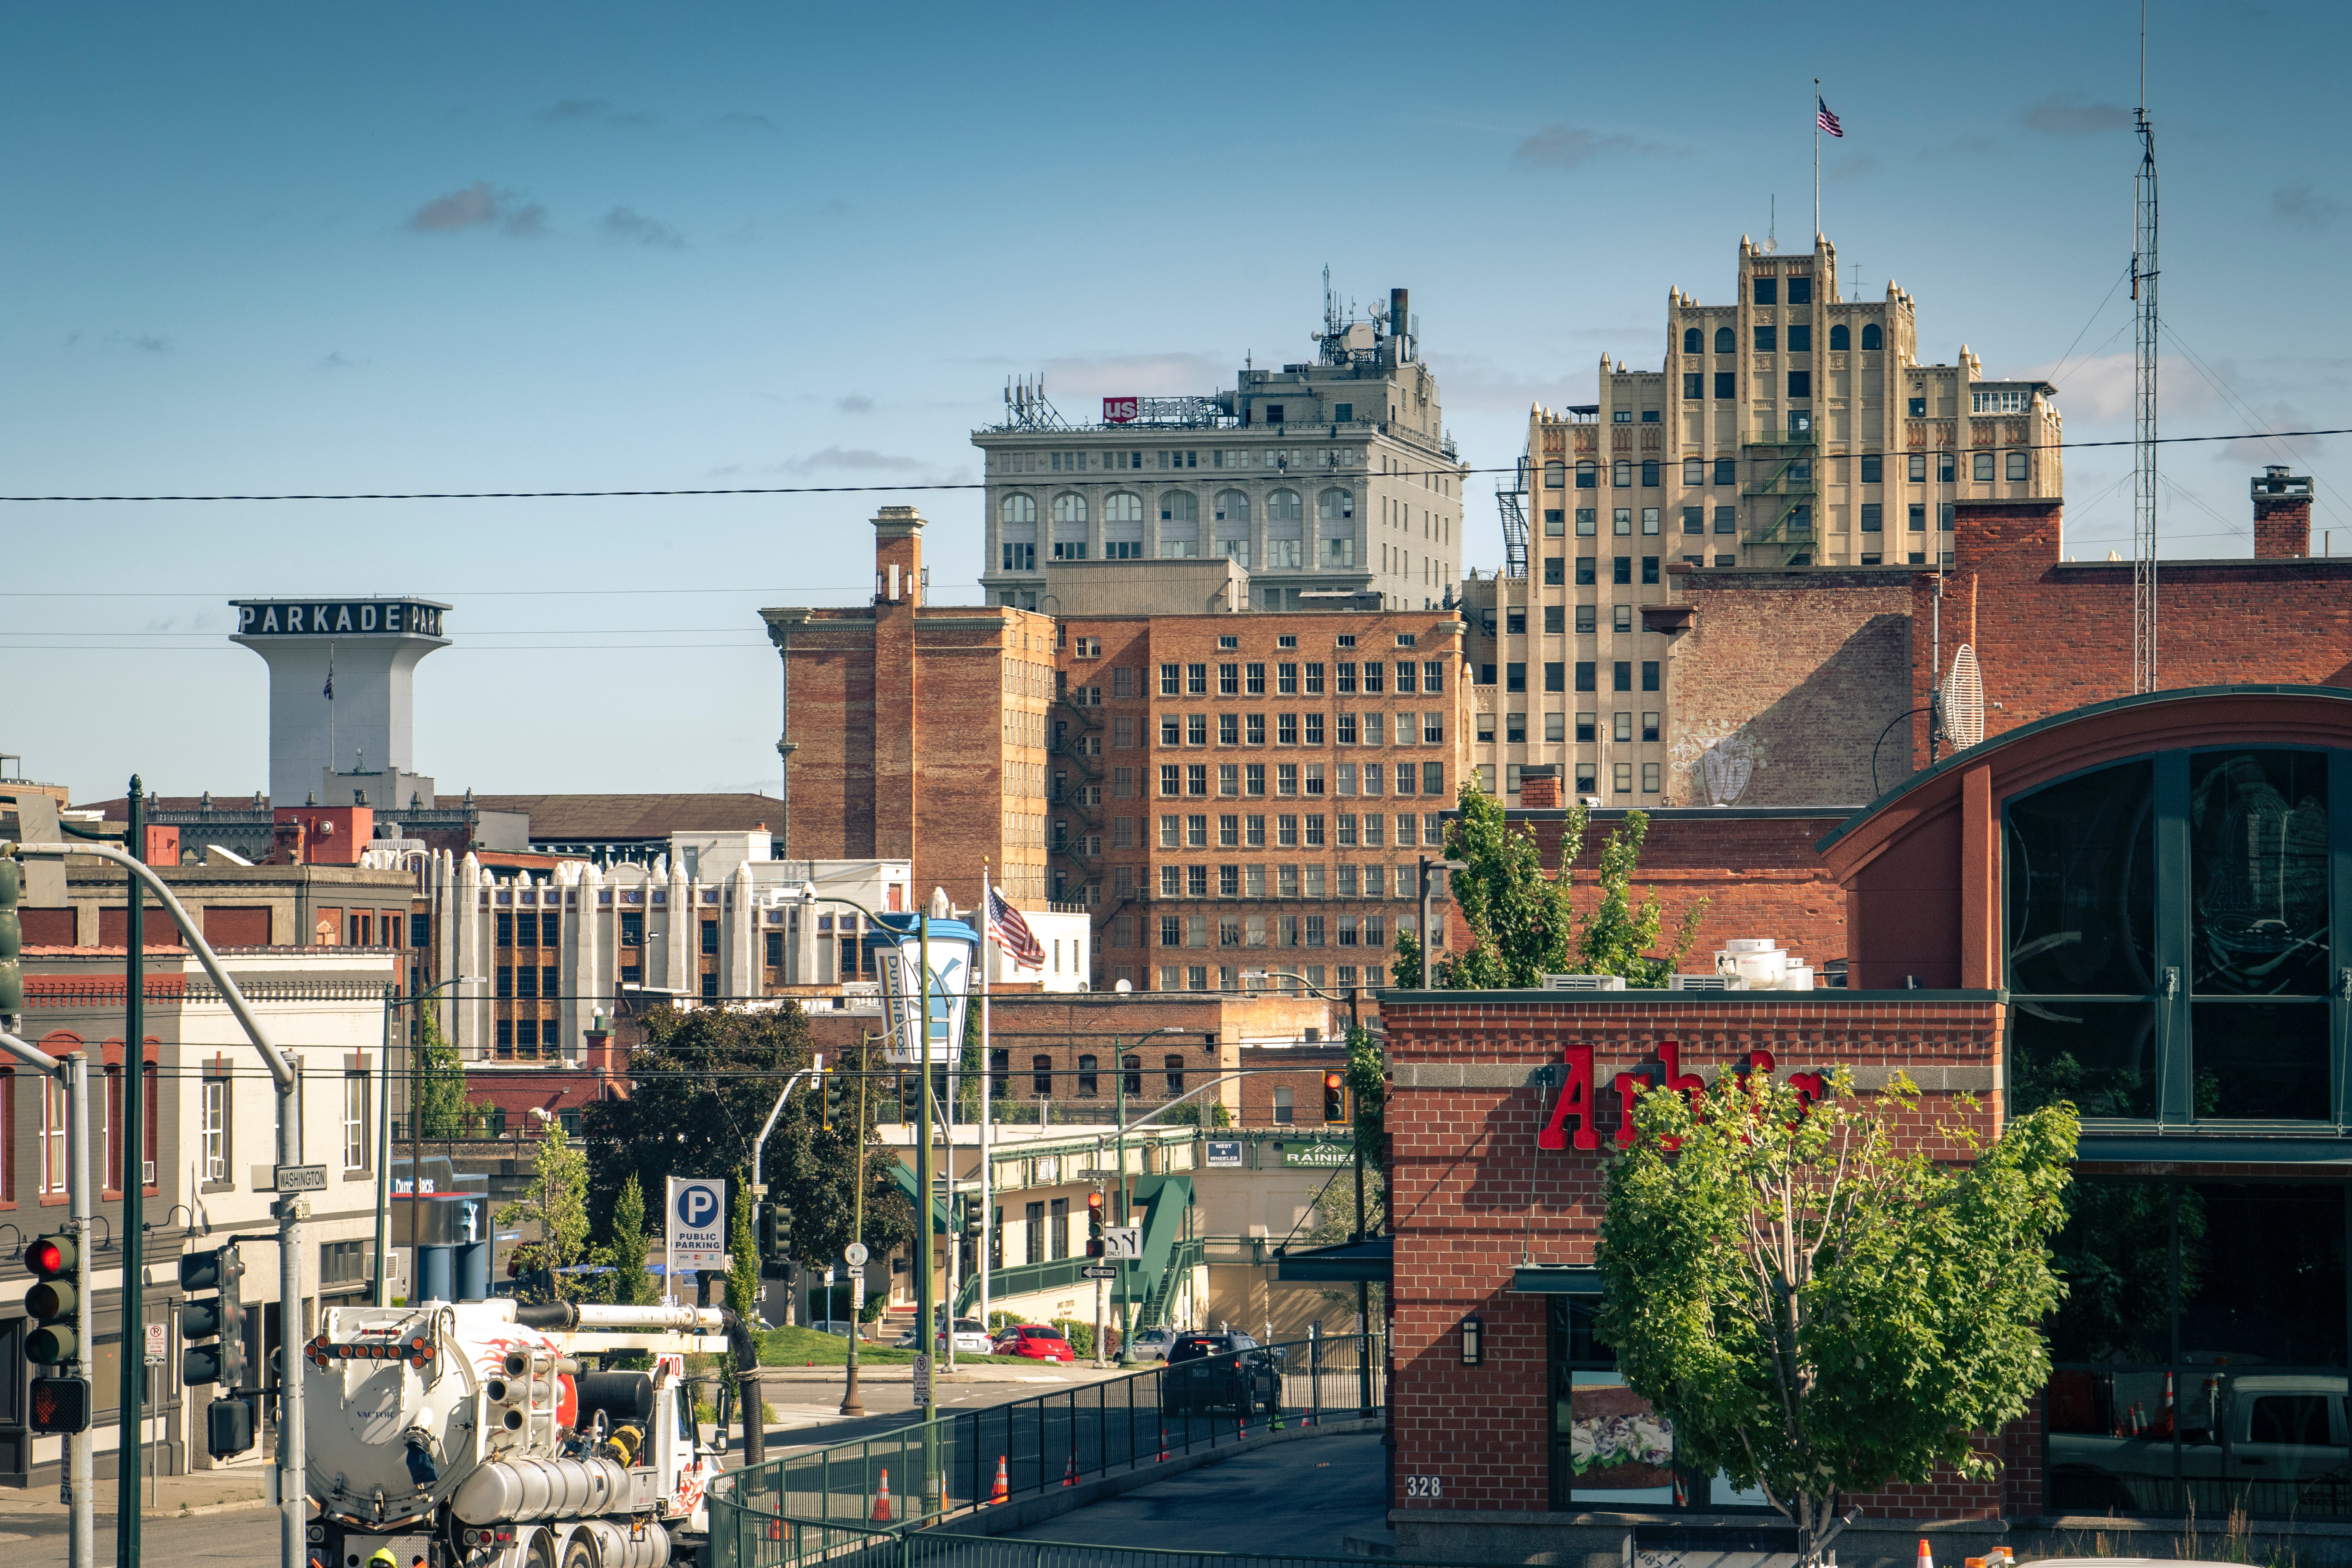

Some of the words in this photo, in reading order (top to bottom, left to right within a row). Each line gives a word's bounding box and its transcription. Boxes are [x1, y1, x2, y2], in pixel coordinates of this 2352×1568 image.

[240, 604, 400, 631] PARKADE
[888, 956, 903, 1010] DUTCH
[894, 1014, 906, 1056] BROS
[1538, 1040, 1822, 1151] Arb'
[280, 1170, 325, 1188] WASHINGTON
[396, 1179, 413, 1194] DUTC
[689, 1191, 712, 1223] P
[1408, 1477, 1440, 1496] 328
